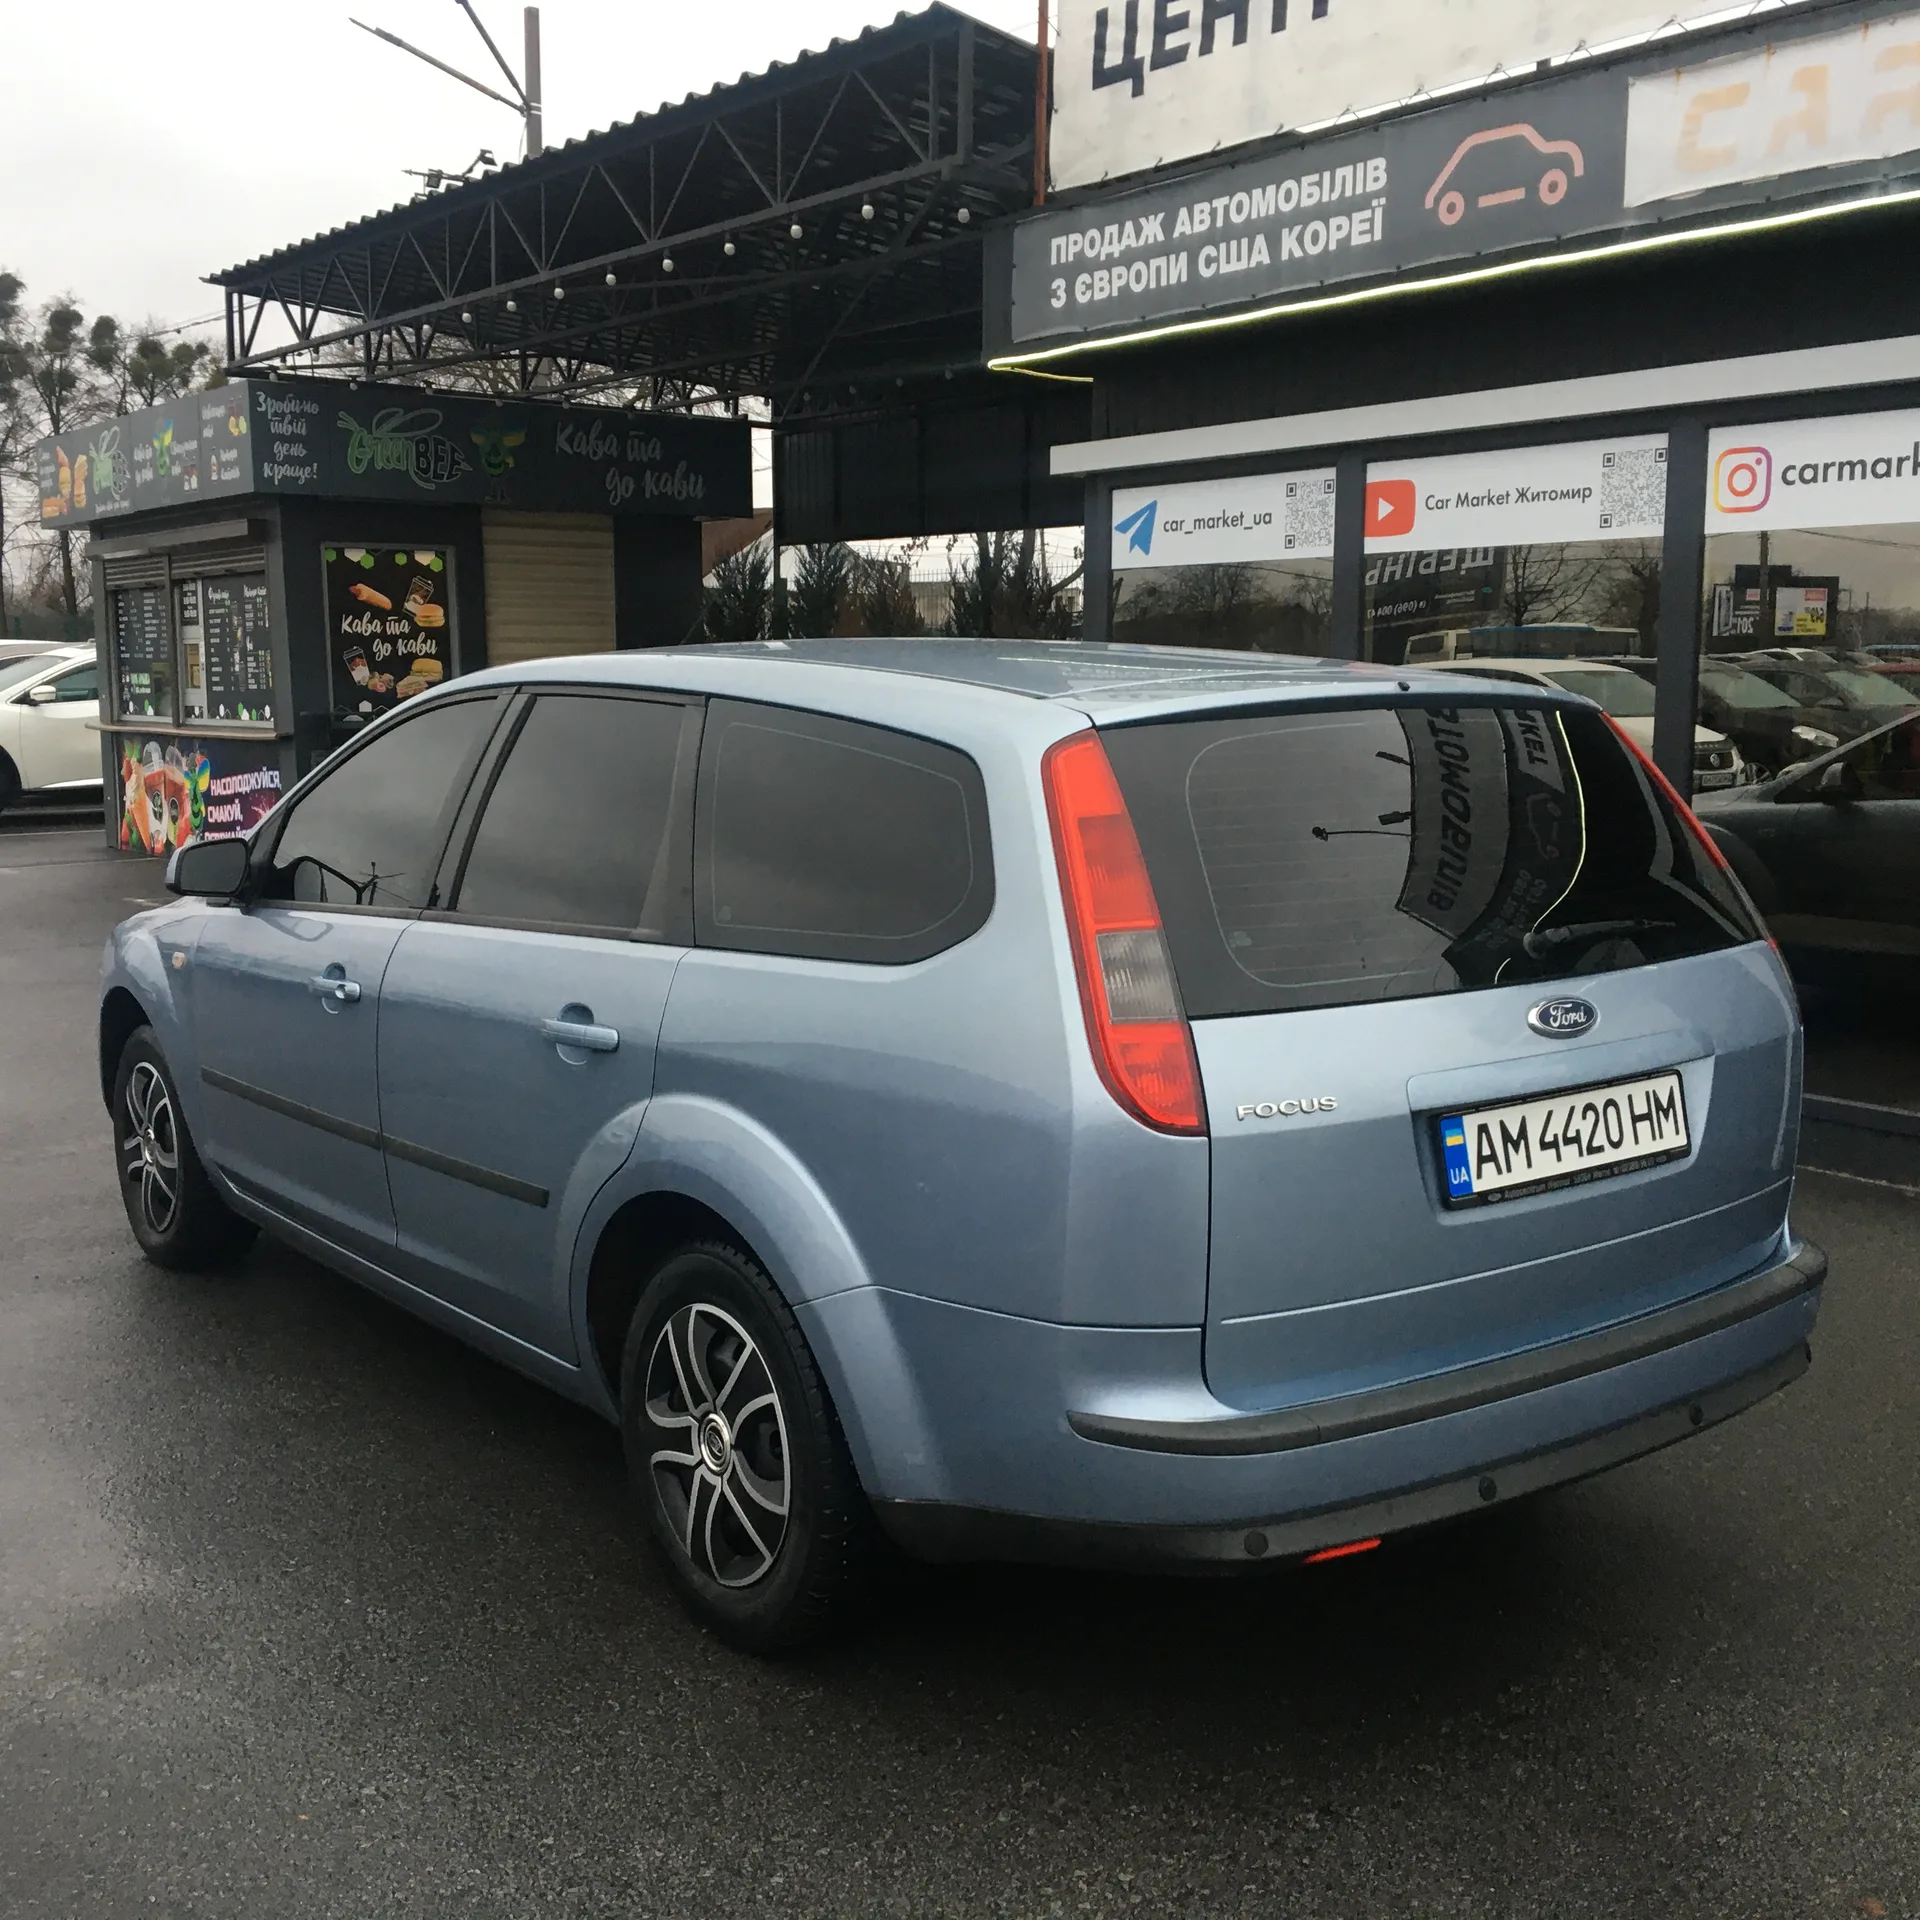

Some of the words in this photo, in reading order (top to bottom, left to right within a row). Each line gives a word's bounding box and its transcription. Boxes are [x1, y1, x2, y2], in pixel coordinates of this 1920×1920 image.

[1092, 0, 1329, 98] ЦЕН
[1050, 212, 1164, 266] ПРОДАЖ
[1173, 157, 1388, 238] АВТОМОБІЛІВ
[1050, 276, 1066, 309] З
[1074, 251, 1188, 304] ЄВРОПИ
[1198, 233, 1270, 278] США
[1281, 197, 1387, 261] КОРЕЇ
[256, 391, 320, 415] Зробимо
[270, 415, 307, 436] твій
[273, 440, 308, 461] день
[556, 418, 617, 461] Кава
[626, 430, 662, 463] та
[262, 461, 318, 485] краще!
[605, 467, 636, 506] до
[642, 460, 707, 500] кави
[1425, 494, 1452, 511] Car
[1455, 488, 1511, 509] Market
[1514, 485, 1593, 505] Житомир
[1162, 509, 1273, 535] car_market_ua
[341, 611, 383, 636] Кава
[385, 616, 411, 635] та
[372, 638, 392, 661] до
[396, 632, 438, 656] кави
[207, 798, 243, 823] СМАКУЙ,
[1550, 1005, 1588, 1028] Ford
[1236, 1096, 1338, 1121] FOCUS
[1476, 1115, 1532, 1180] AM
[1539, 1098, 1624, 1162] 4420
[1628, 1085, 1680, 1146] HM
[1450, 1166, 1469, 1185] UA
